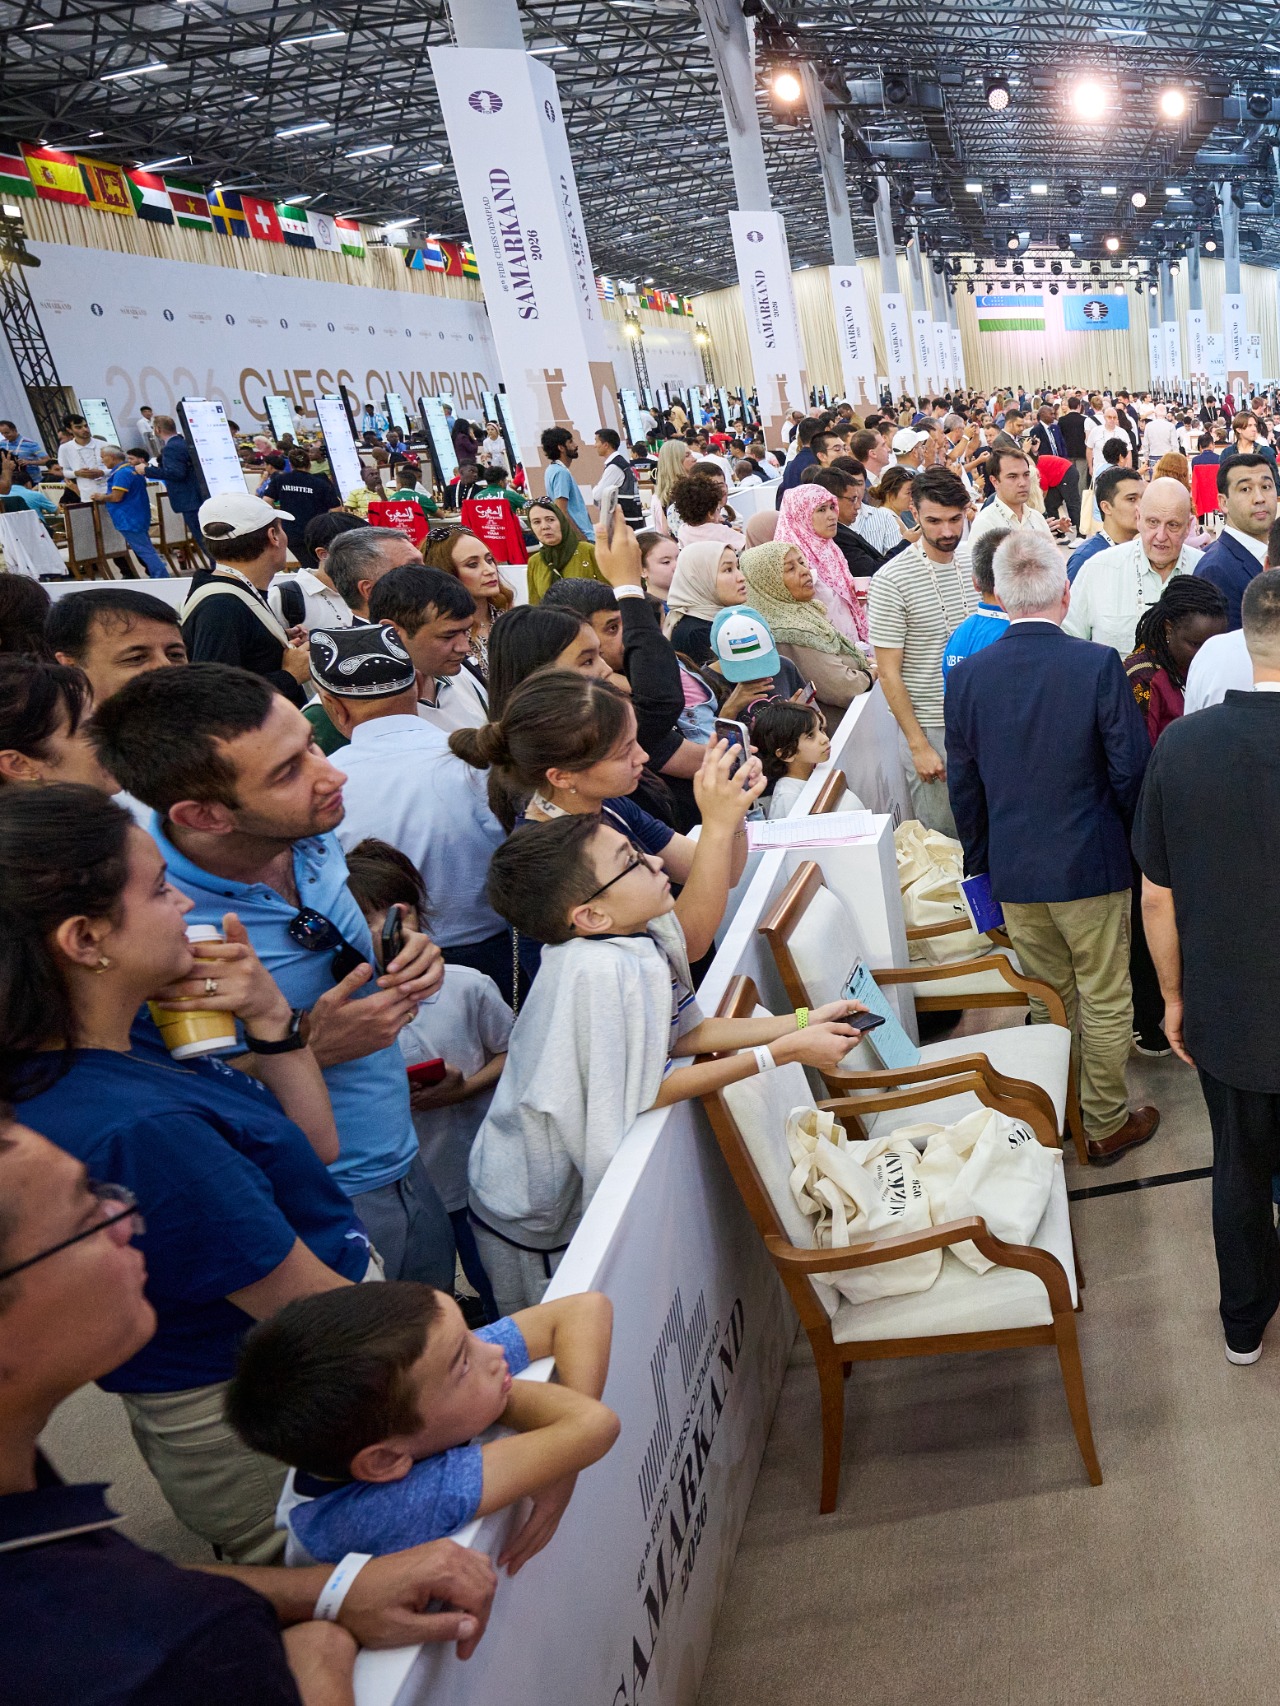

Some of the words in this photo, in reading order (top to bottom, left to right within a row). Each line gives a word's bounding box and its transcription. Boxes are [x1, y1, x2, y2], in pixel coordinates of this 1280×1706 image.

[482, 196, 497, 235] OLYMPIAD
[489, 168, 539, 319] SAMARKAND
[491, 235, 502, 259] CHESS
[526, 229, 543, 261] 2026
[496, 261, 506, 279] FIDE
[755, 270, 775, 349] SAMARKAND
[845, 306, 858, 359] SAMARKAND
[239, 367, 356, 422] CHESS
[281, 485, 313, 494] ARBITER
[650, 1482, 669, 1549] FIDE
[690, 1320, 720, 1415] OLYMPIAD
